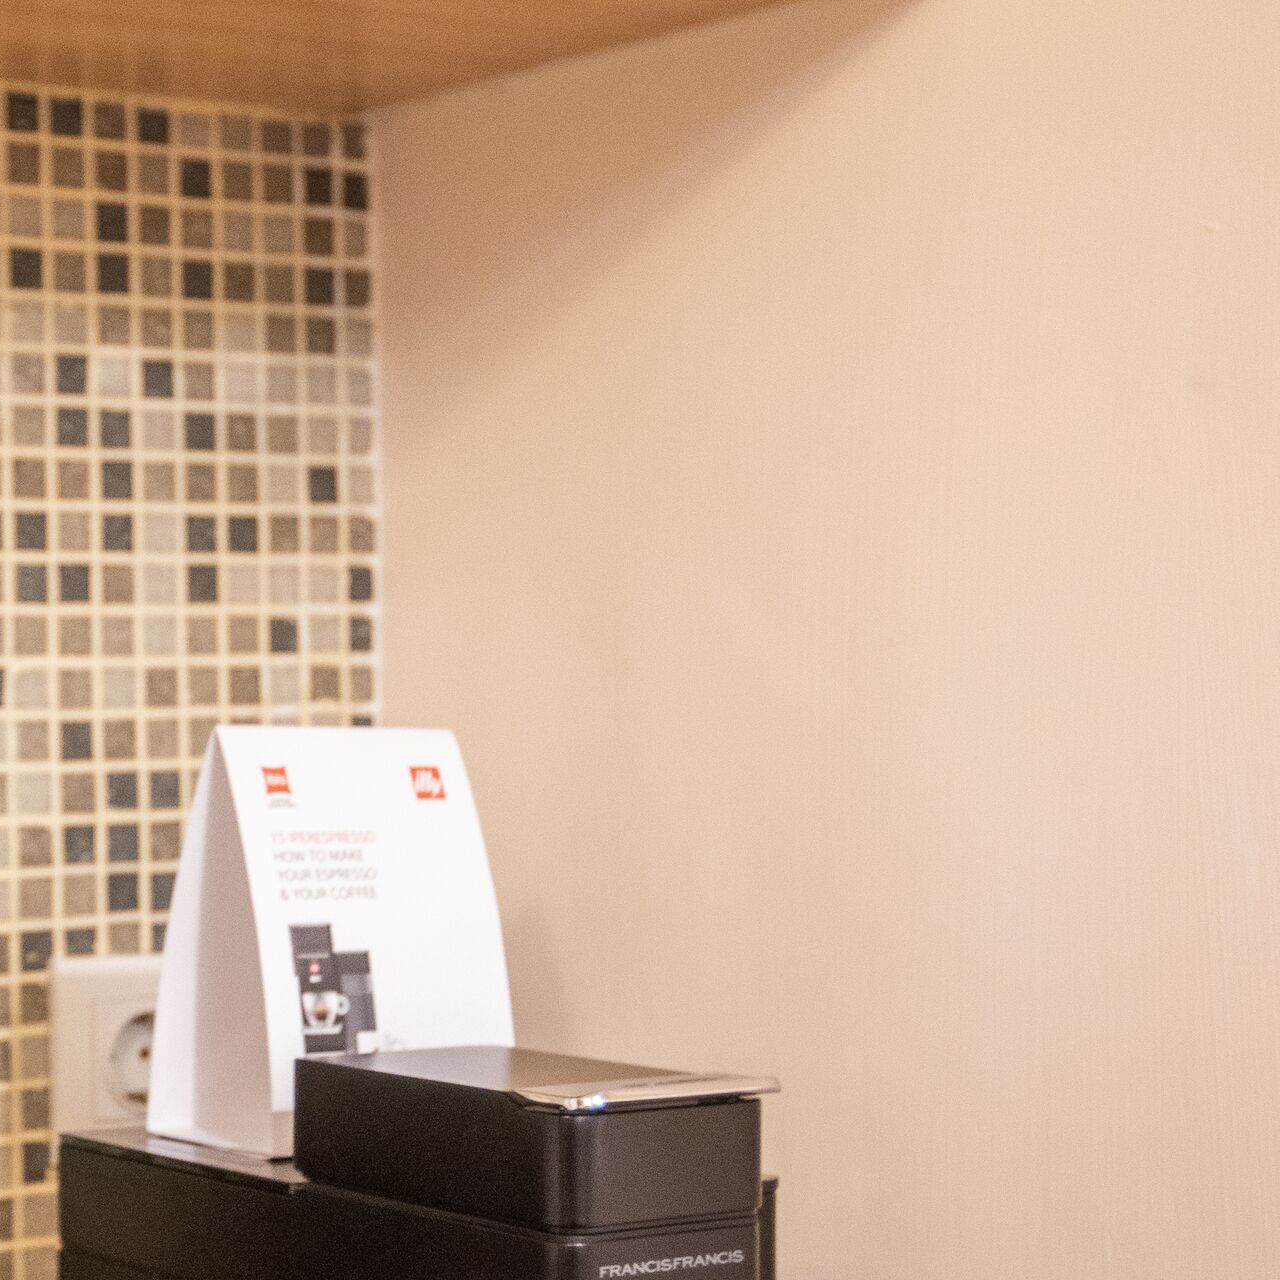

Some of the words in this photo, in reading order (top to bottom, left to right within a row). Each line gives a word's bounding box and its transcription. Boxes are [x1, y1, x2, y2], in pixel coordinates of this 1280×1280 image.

[274, 850, 305, 862] HOW
[309, 849, 327, 862] TO
[330, 849, 363, 861] MAKE
[278, 869, 312, 881] YOUR
[294, 888, 327, 900] YOUR
[329, 887, 376, 899] COFFEE
